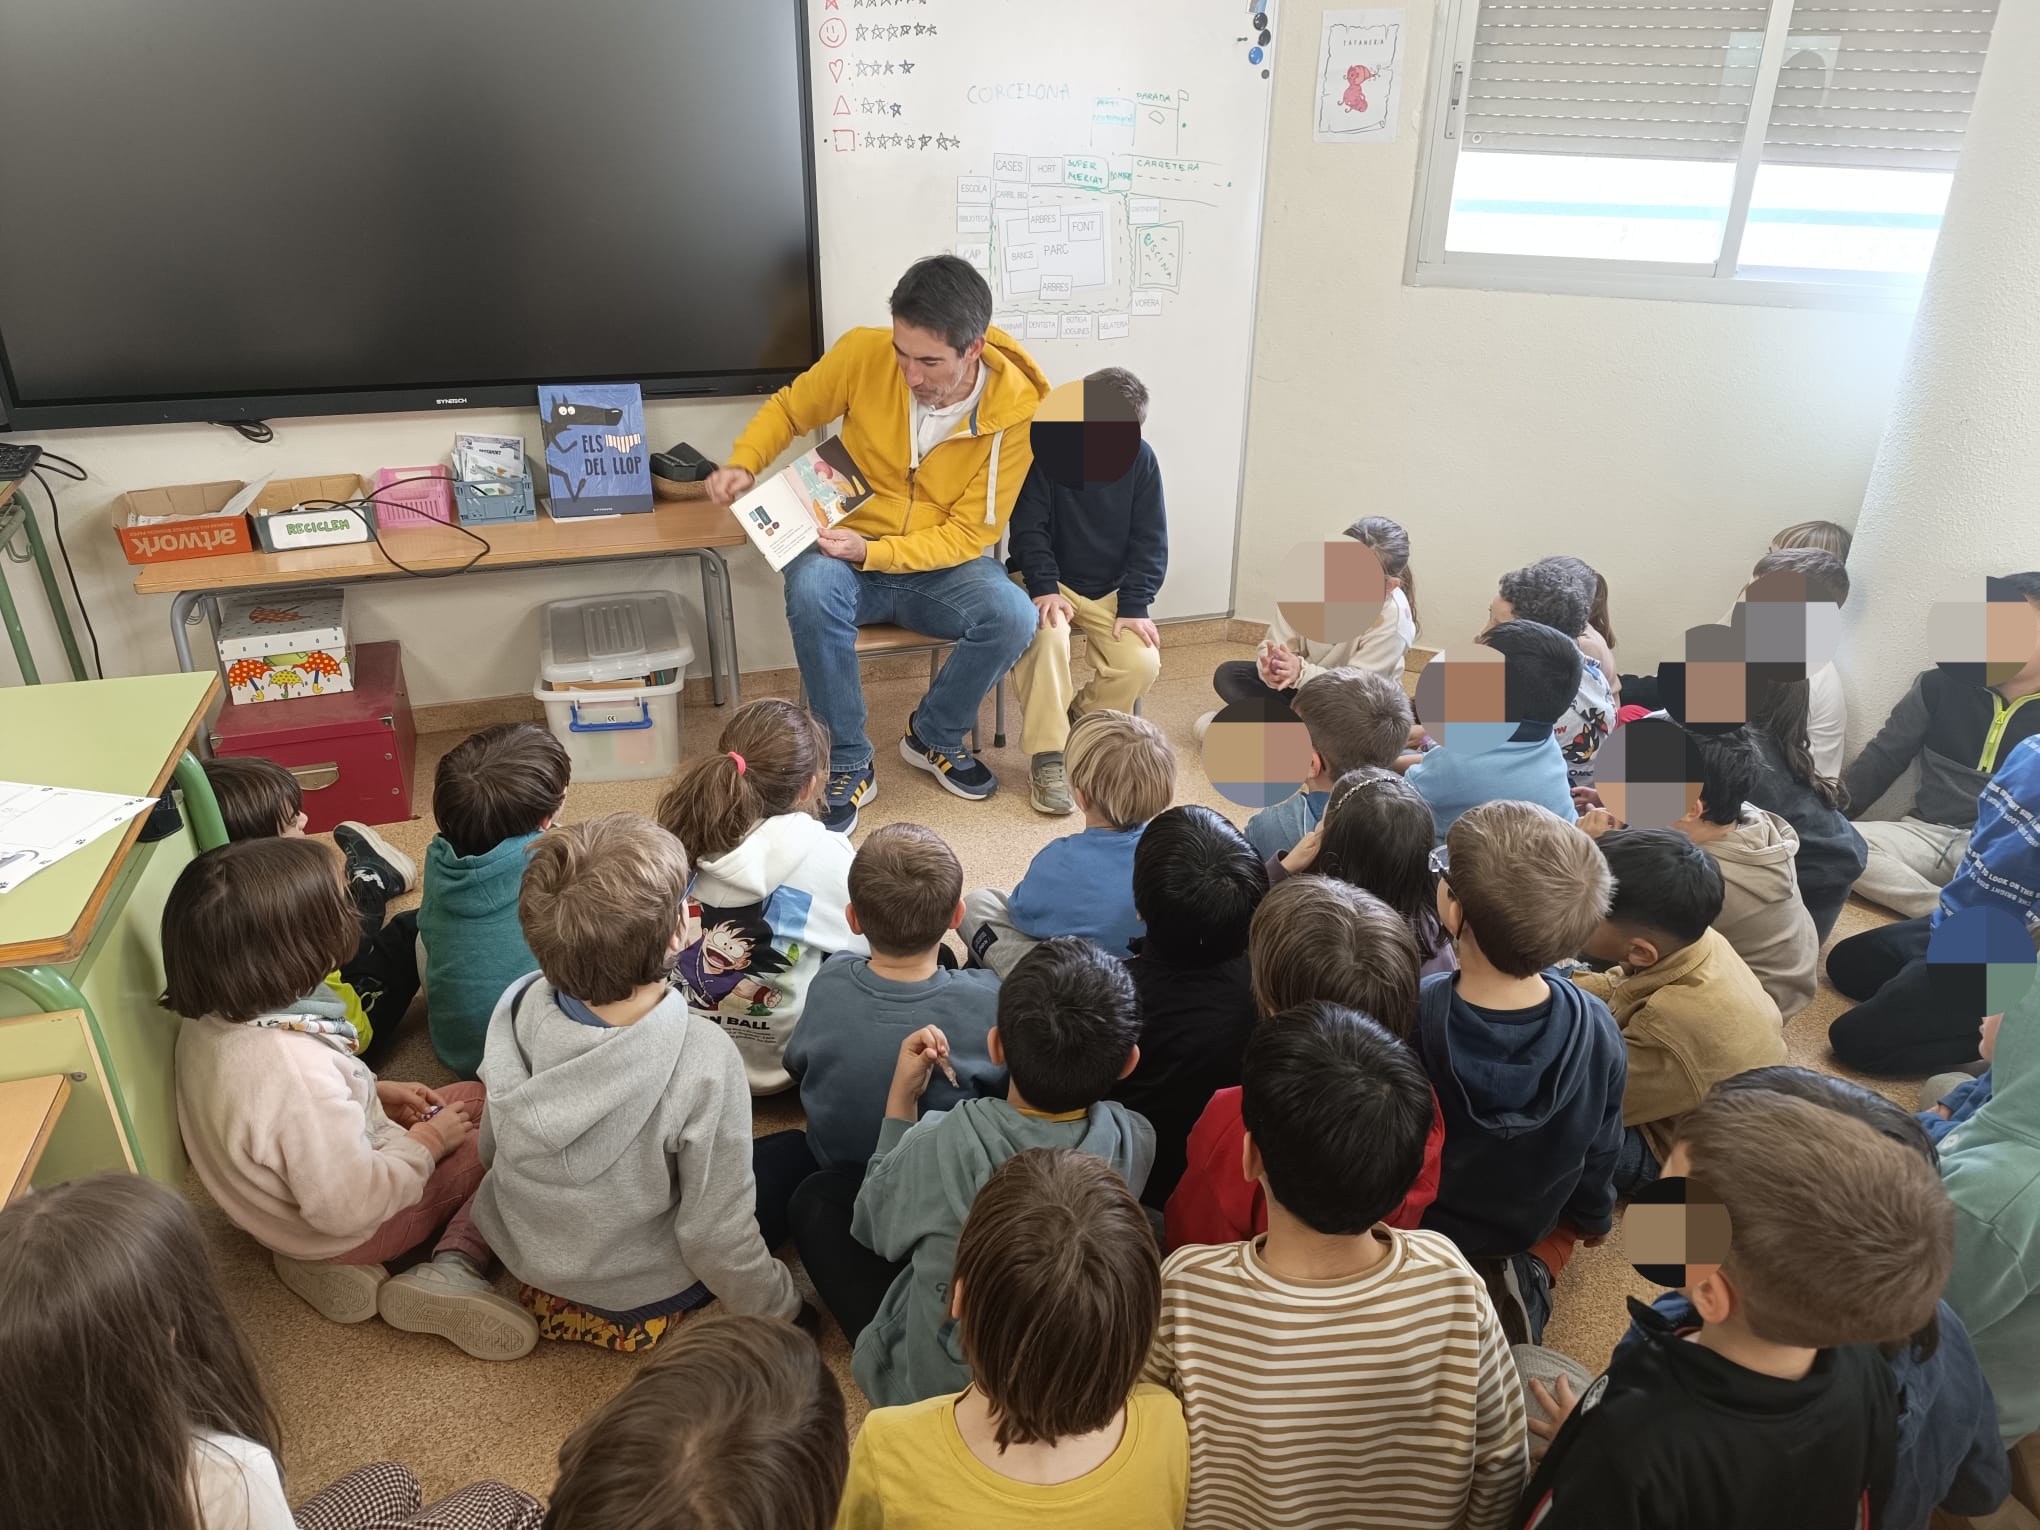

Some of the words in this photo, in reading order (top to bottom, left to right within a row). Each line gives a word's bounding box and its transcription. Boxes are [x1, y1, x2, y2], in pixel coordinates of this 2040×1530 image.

[966, 82, 1071, 104] CORCELONA
[995, 160, 1023, 172] CASES
[1038, 164, 1056, 173] HORT
[1067, 159, 1097, 170] SUPER
[1136, 159, 1200, 172] CARRETERA
[960, 184, 987, 193] ESCOLA
[1030, 214, 1056, 224] ARBRES
[1072, 220, 1095, 232] FONT
[963, 249, 981, 260] CAP
[1044, 243, 1069, 256] PARC
[1011, 251, 1034, 261] BANCS
[1042, 282, 1069, 293] ARBRES
[1028, 321, 1056, 330] DENTISTA
[582, 434, 603, 453] ELS
[584, 457, 607, 476] DEL
[613, 456, 641, 475] LLOP
[286, 518, 350, 536] RECICLEM
[130, 528, 237, 557] artwork
[1989, 873, 2010, 886] LOOK
[2009, 881, 2021, 890] ON
[2020, 886, 2035, 897] THE
[1990, 886, 2018, 901] BRIGHT
[727, 1016, 770, 1030] BALL
